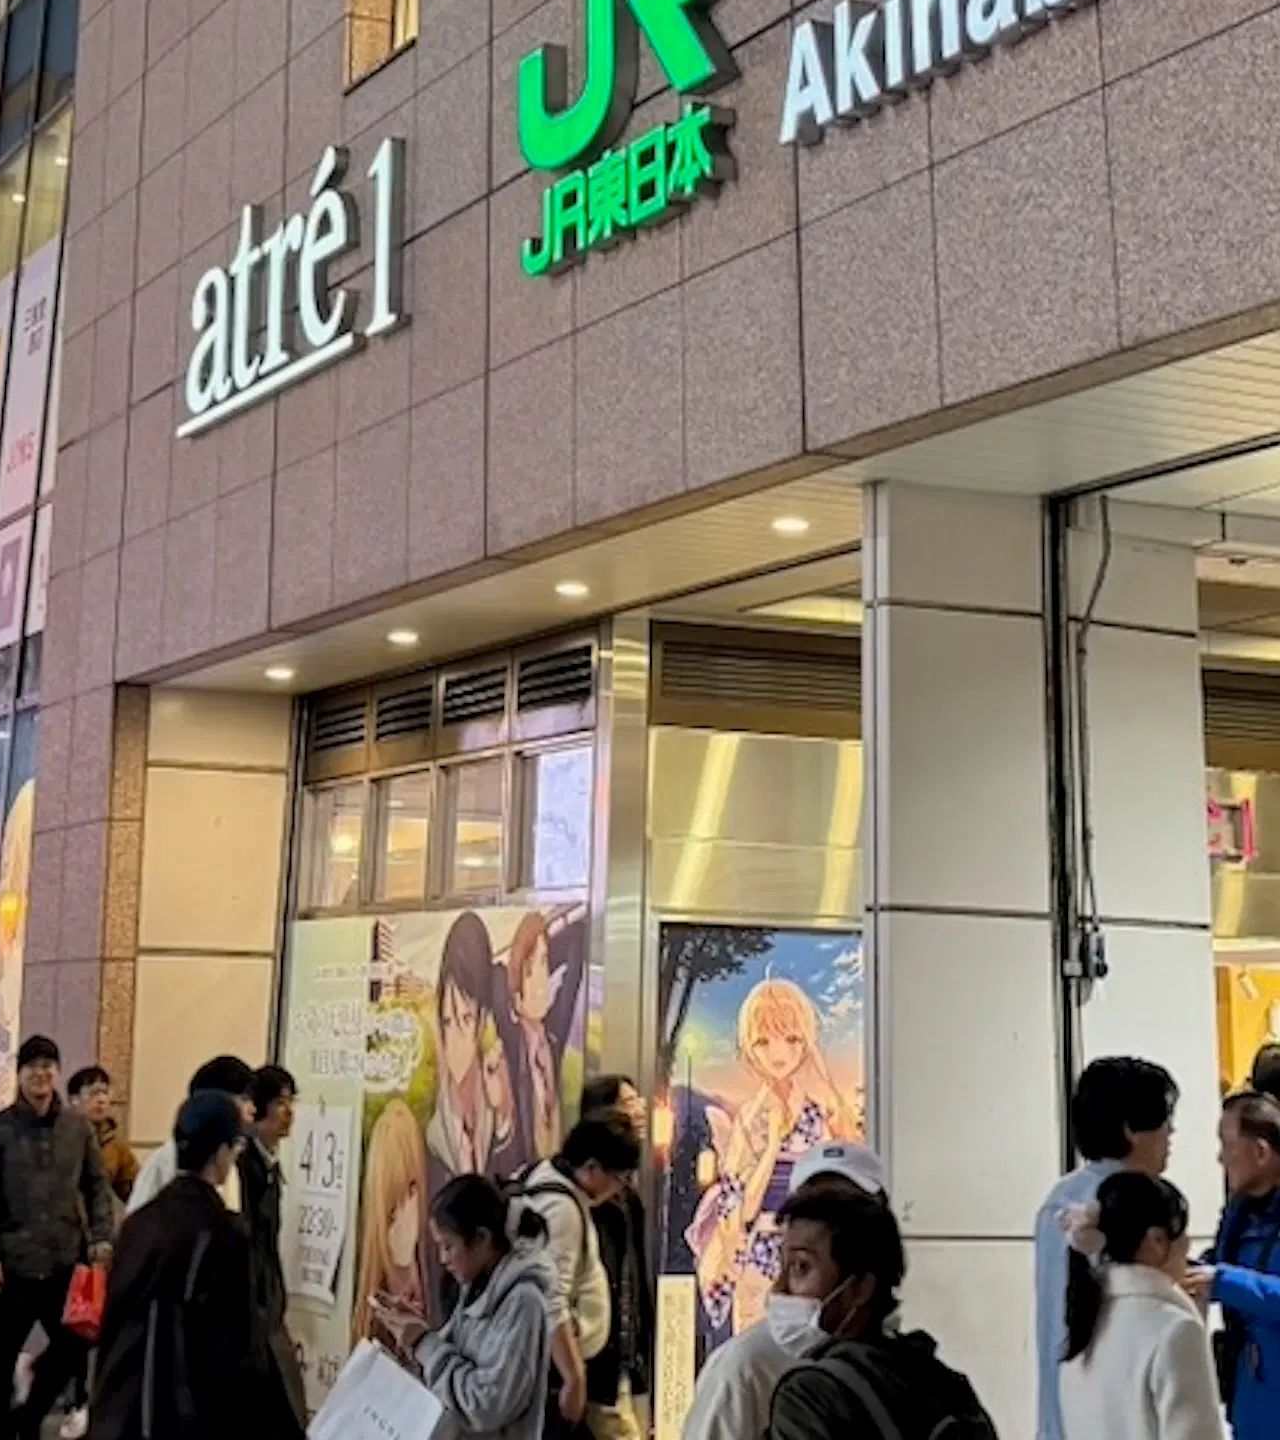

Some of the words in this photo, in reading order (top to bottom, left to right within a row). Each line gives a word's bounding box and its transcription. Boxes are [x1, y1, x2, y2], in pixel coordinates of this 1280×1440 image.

[185, 145, 353, 416] atré
[521, 100, 718, 278] JR東日本
